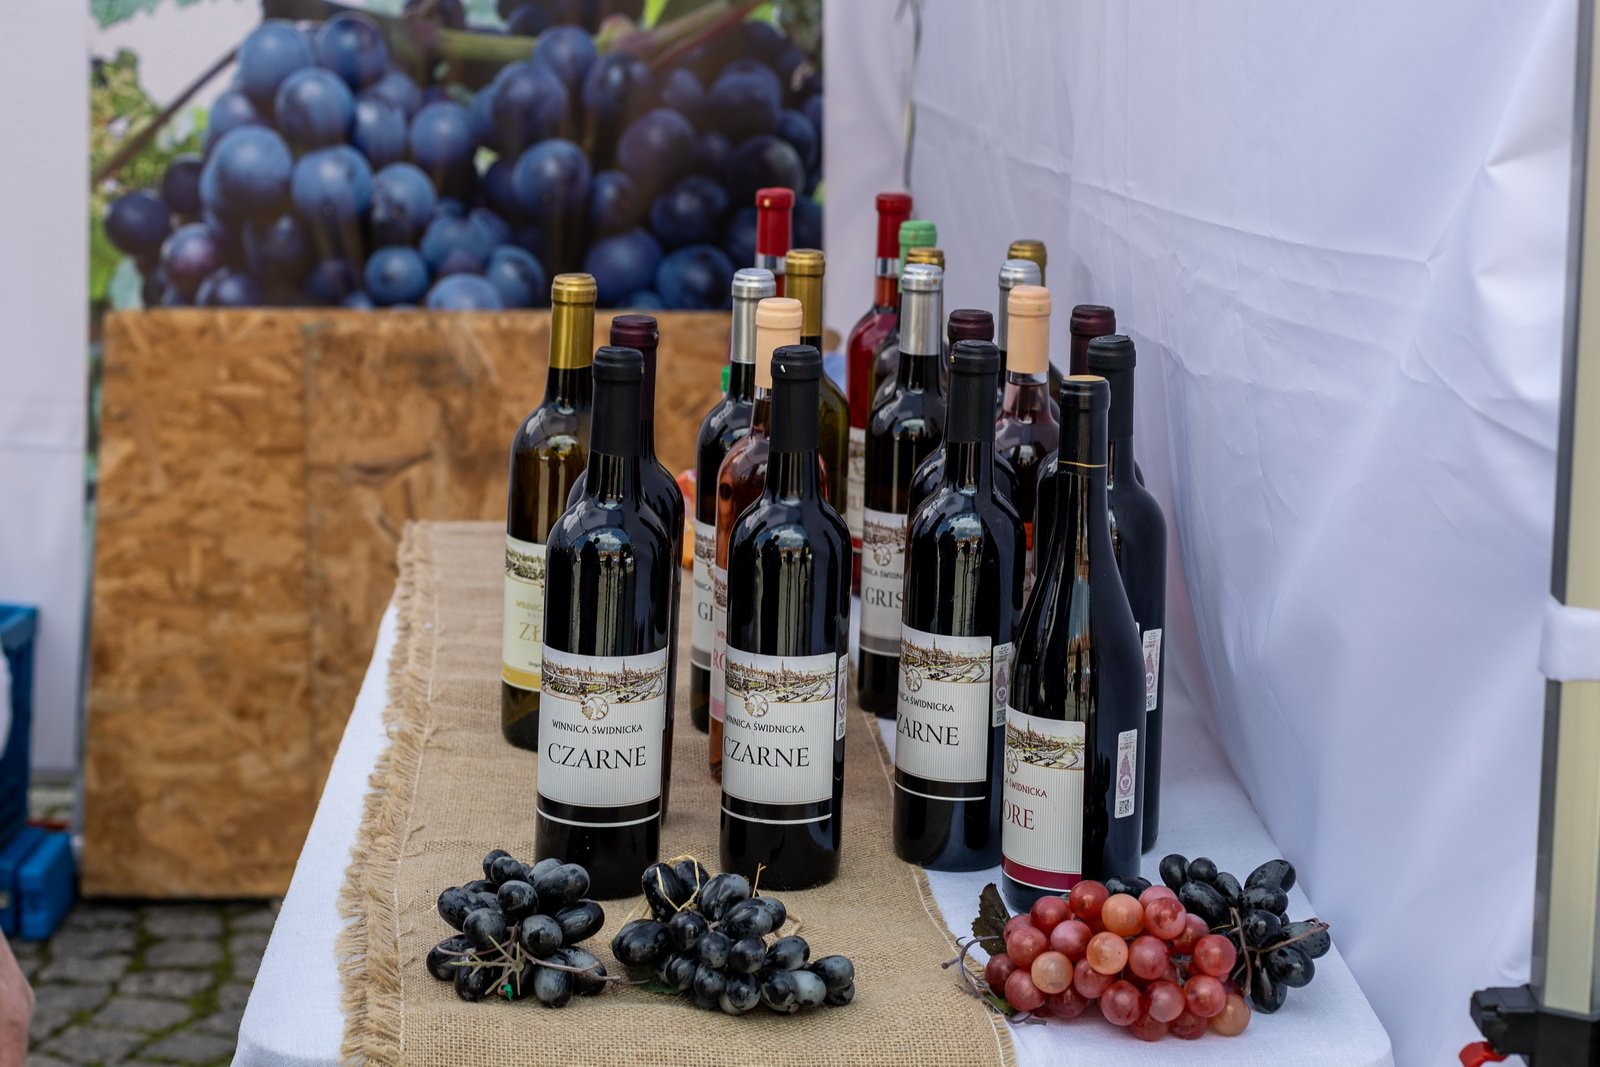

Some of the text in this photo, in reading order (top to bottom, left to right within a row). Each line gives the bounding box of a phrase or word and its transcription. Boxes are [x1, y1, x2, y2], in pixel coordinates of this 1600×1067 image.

[910, 695, 955, 713] ŚWIDNICKA
[552, 719, 643, 735] WINNICA ŚWIDNICKA
[754, 721, 805, 734] ŚWIDNICKA
[897, 712, 959, 747] ZARNE
[548, 742, 647, 770] CZARNE
[724, 736, 810, 768] CZARNE
[1004, 798, 1034, 831] ORE
